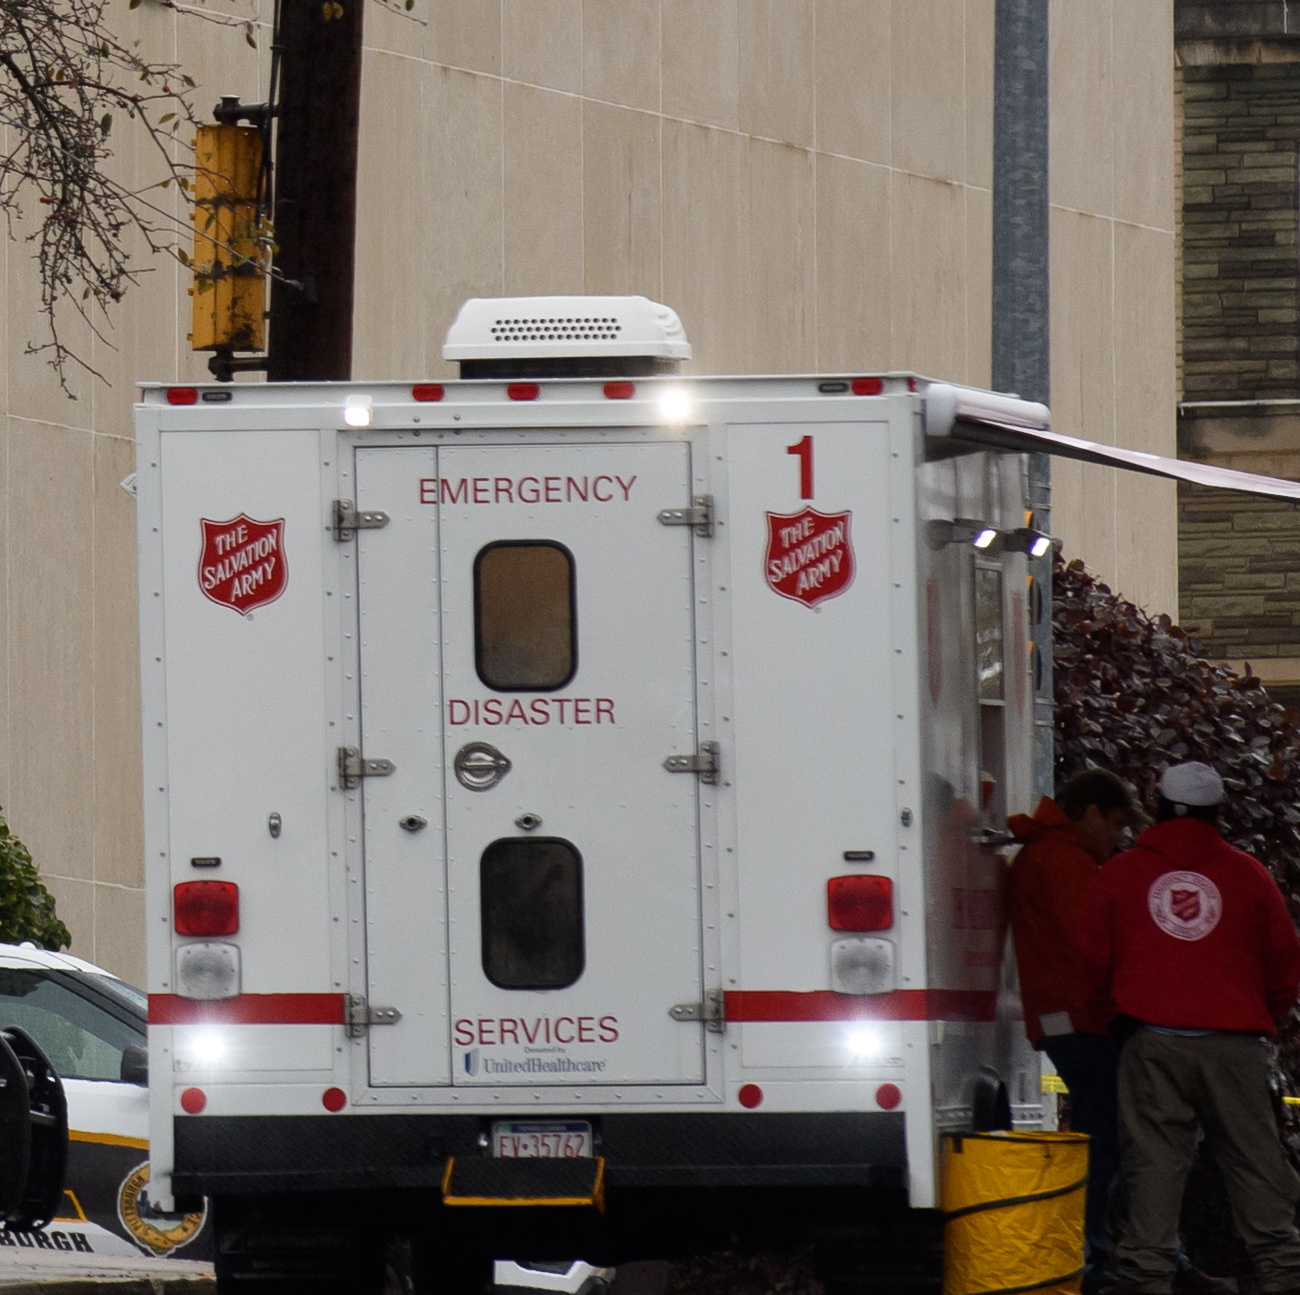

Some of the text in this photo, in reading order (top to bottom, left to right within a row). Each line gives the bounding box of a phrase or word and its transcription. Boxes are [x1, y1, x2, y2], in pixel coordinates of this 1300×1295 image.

[786, 435, 816, 500] 1
[418, 475, 638, 505] EMERGENCY
[214, 523, 250, 557] THE
[779, 517, 816, 549] THE
[203, 528, 279, 591] SALVATION
[769, 521, 846, 585] SALVATION
[230, 557, 277, 603] ARMY
[797, 549, 844, 596] ARMY
[448, 697, 617, 726] DISASTER
[454, 1015, 620, 1047] SERVICES
[483, 1057, 607, 1075] UnitedHealthcare
